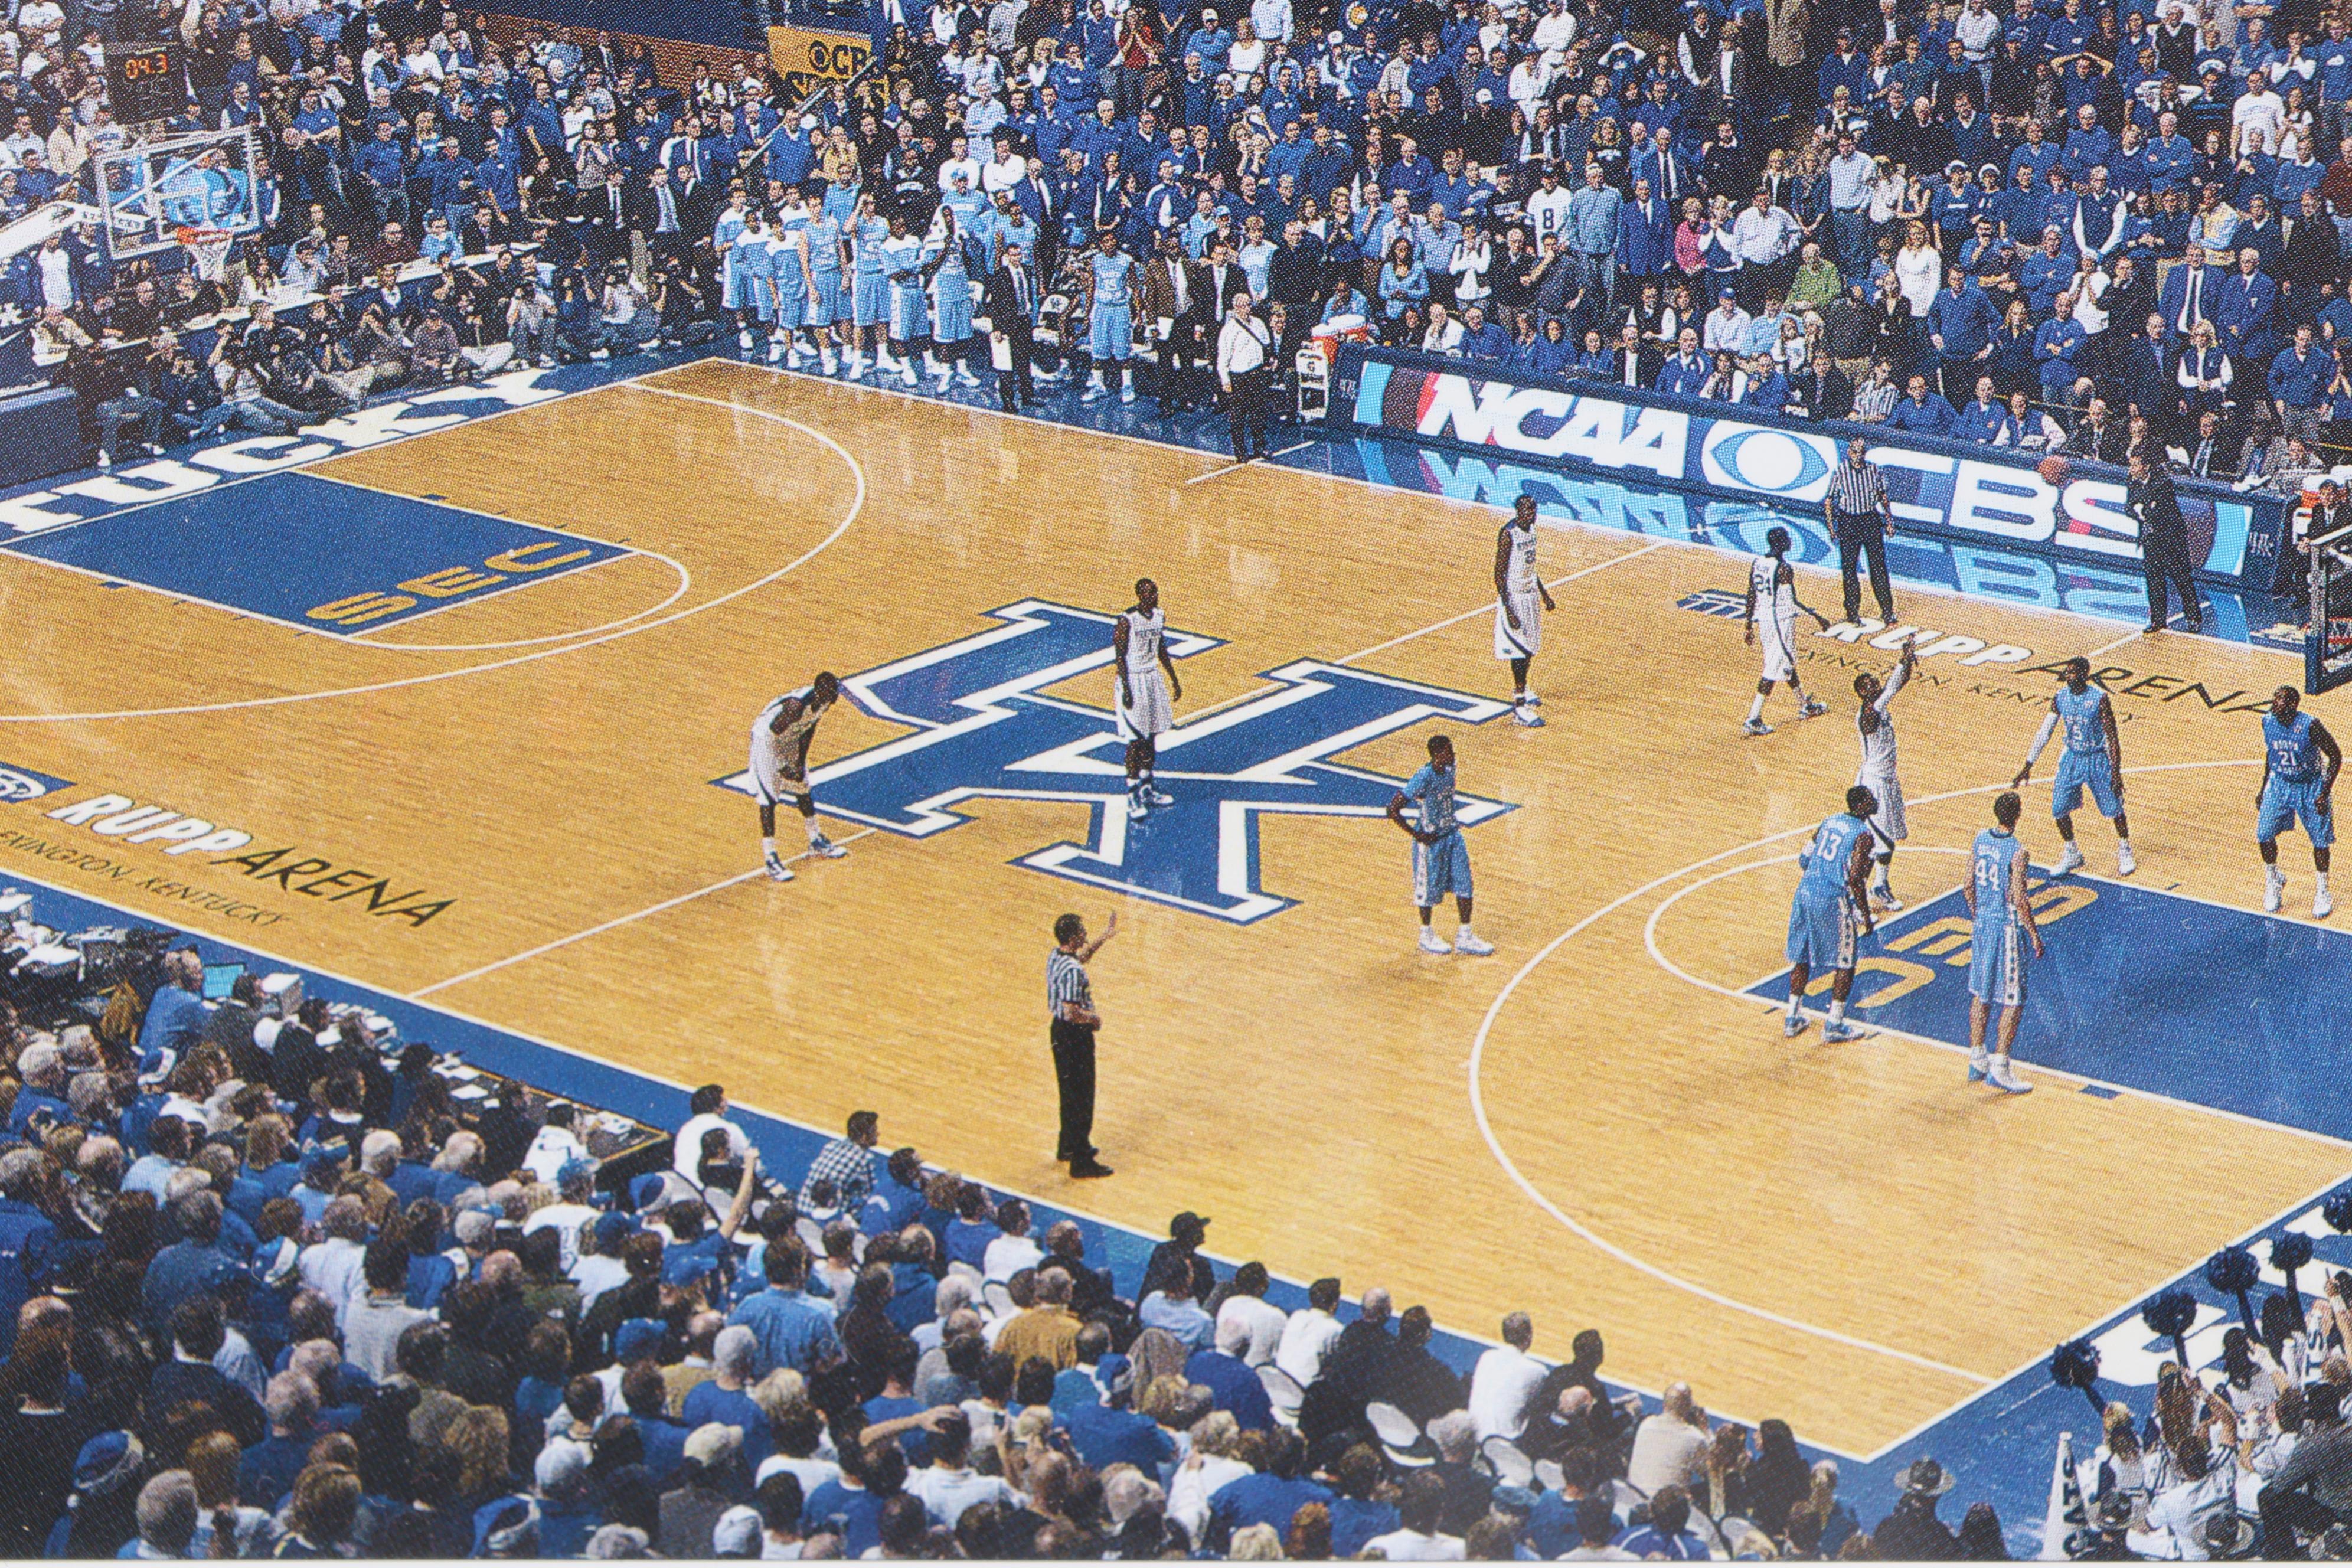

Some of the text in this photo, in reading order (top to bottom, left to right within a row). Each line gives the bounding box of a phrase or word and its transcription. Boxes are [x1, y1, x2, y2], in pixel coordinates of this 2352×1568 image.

[1543, 208, 1554, 230] 8
[1417, 371, 1690, 479] NCAA
[1864, 447, 2145, 560] CBS
[305, 541, 592, 626] SEC
[1812, 618, 2035, 667] RUPP
[2278, 750, 2298, 766] 21
[41, 793, 458, 928] RUPP ARENA
[1817, 829, 1843, 861] 13
[1975, 858, 2000, 891] 44
[136, 875, 292, 927] KENTUCKY
